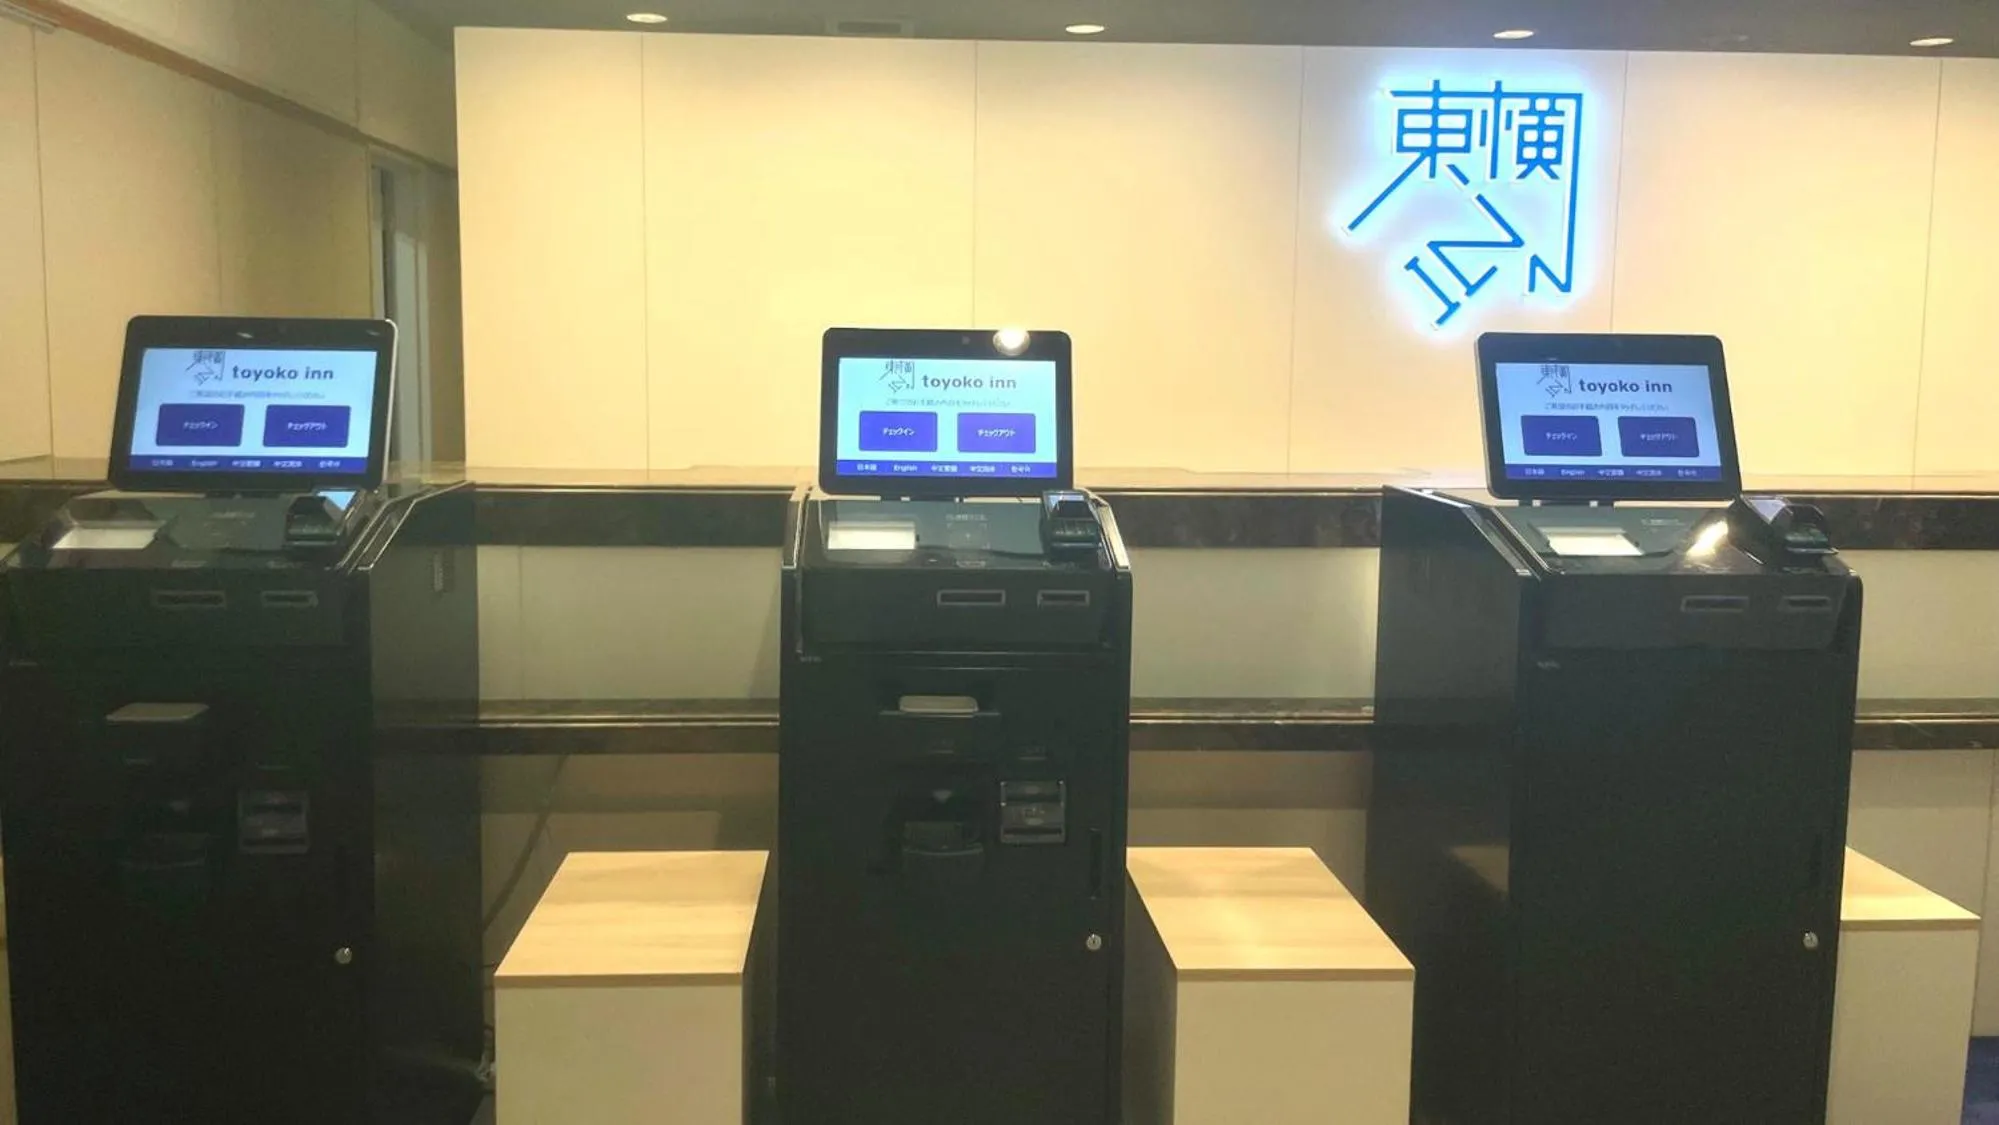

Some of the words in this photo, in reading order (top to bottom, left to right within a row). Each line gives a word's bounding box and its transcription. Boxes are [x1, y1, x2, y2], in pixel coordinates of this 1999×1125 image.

[232, 365, 298, 383] toyoko
[305, 365, 334, 380] inn
[922, 375, 983, 391] toyoko
[989, 375, 1017, 389] inn
[1578, 378, 1640, 395] toyoko
[1646, 379, 1672, 393] inn
[893, 464, 918, 472] English
